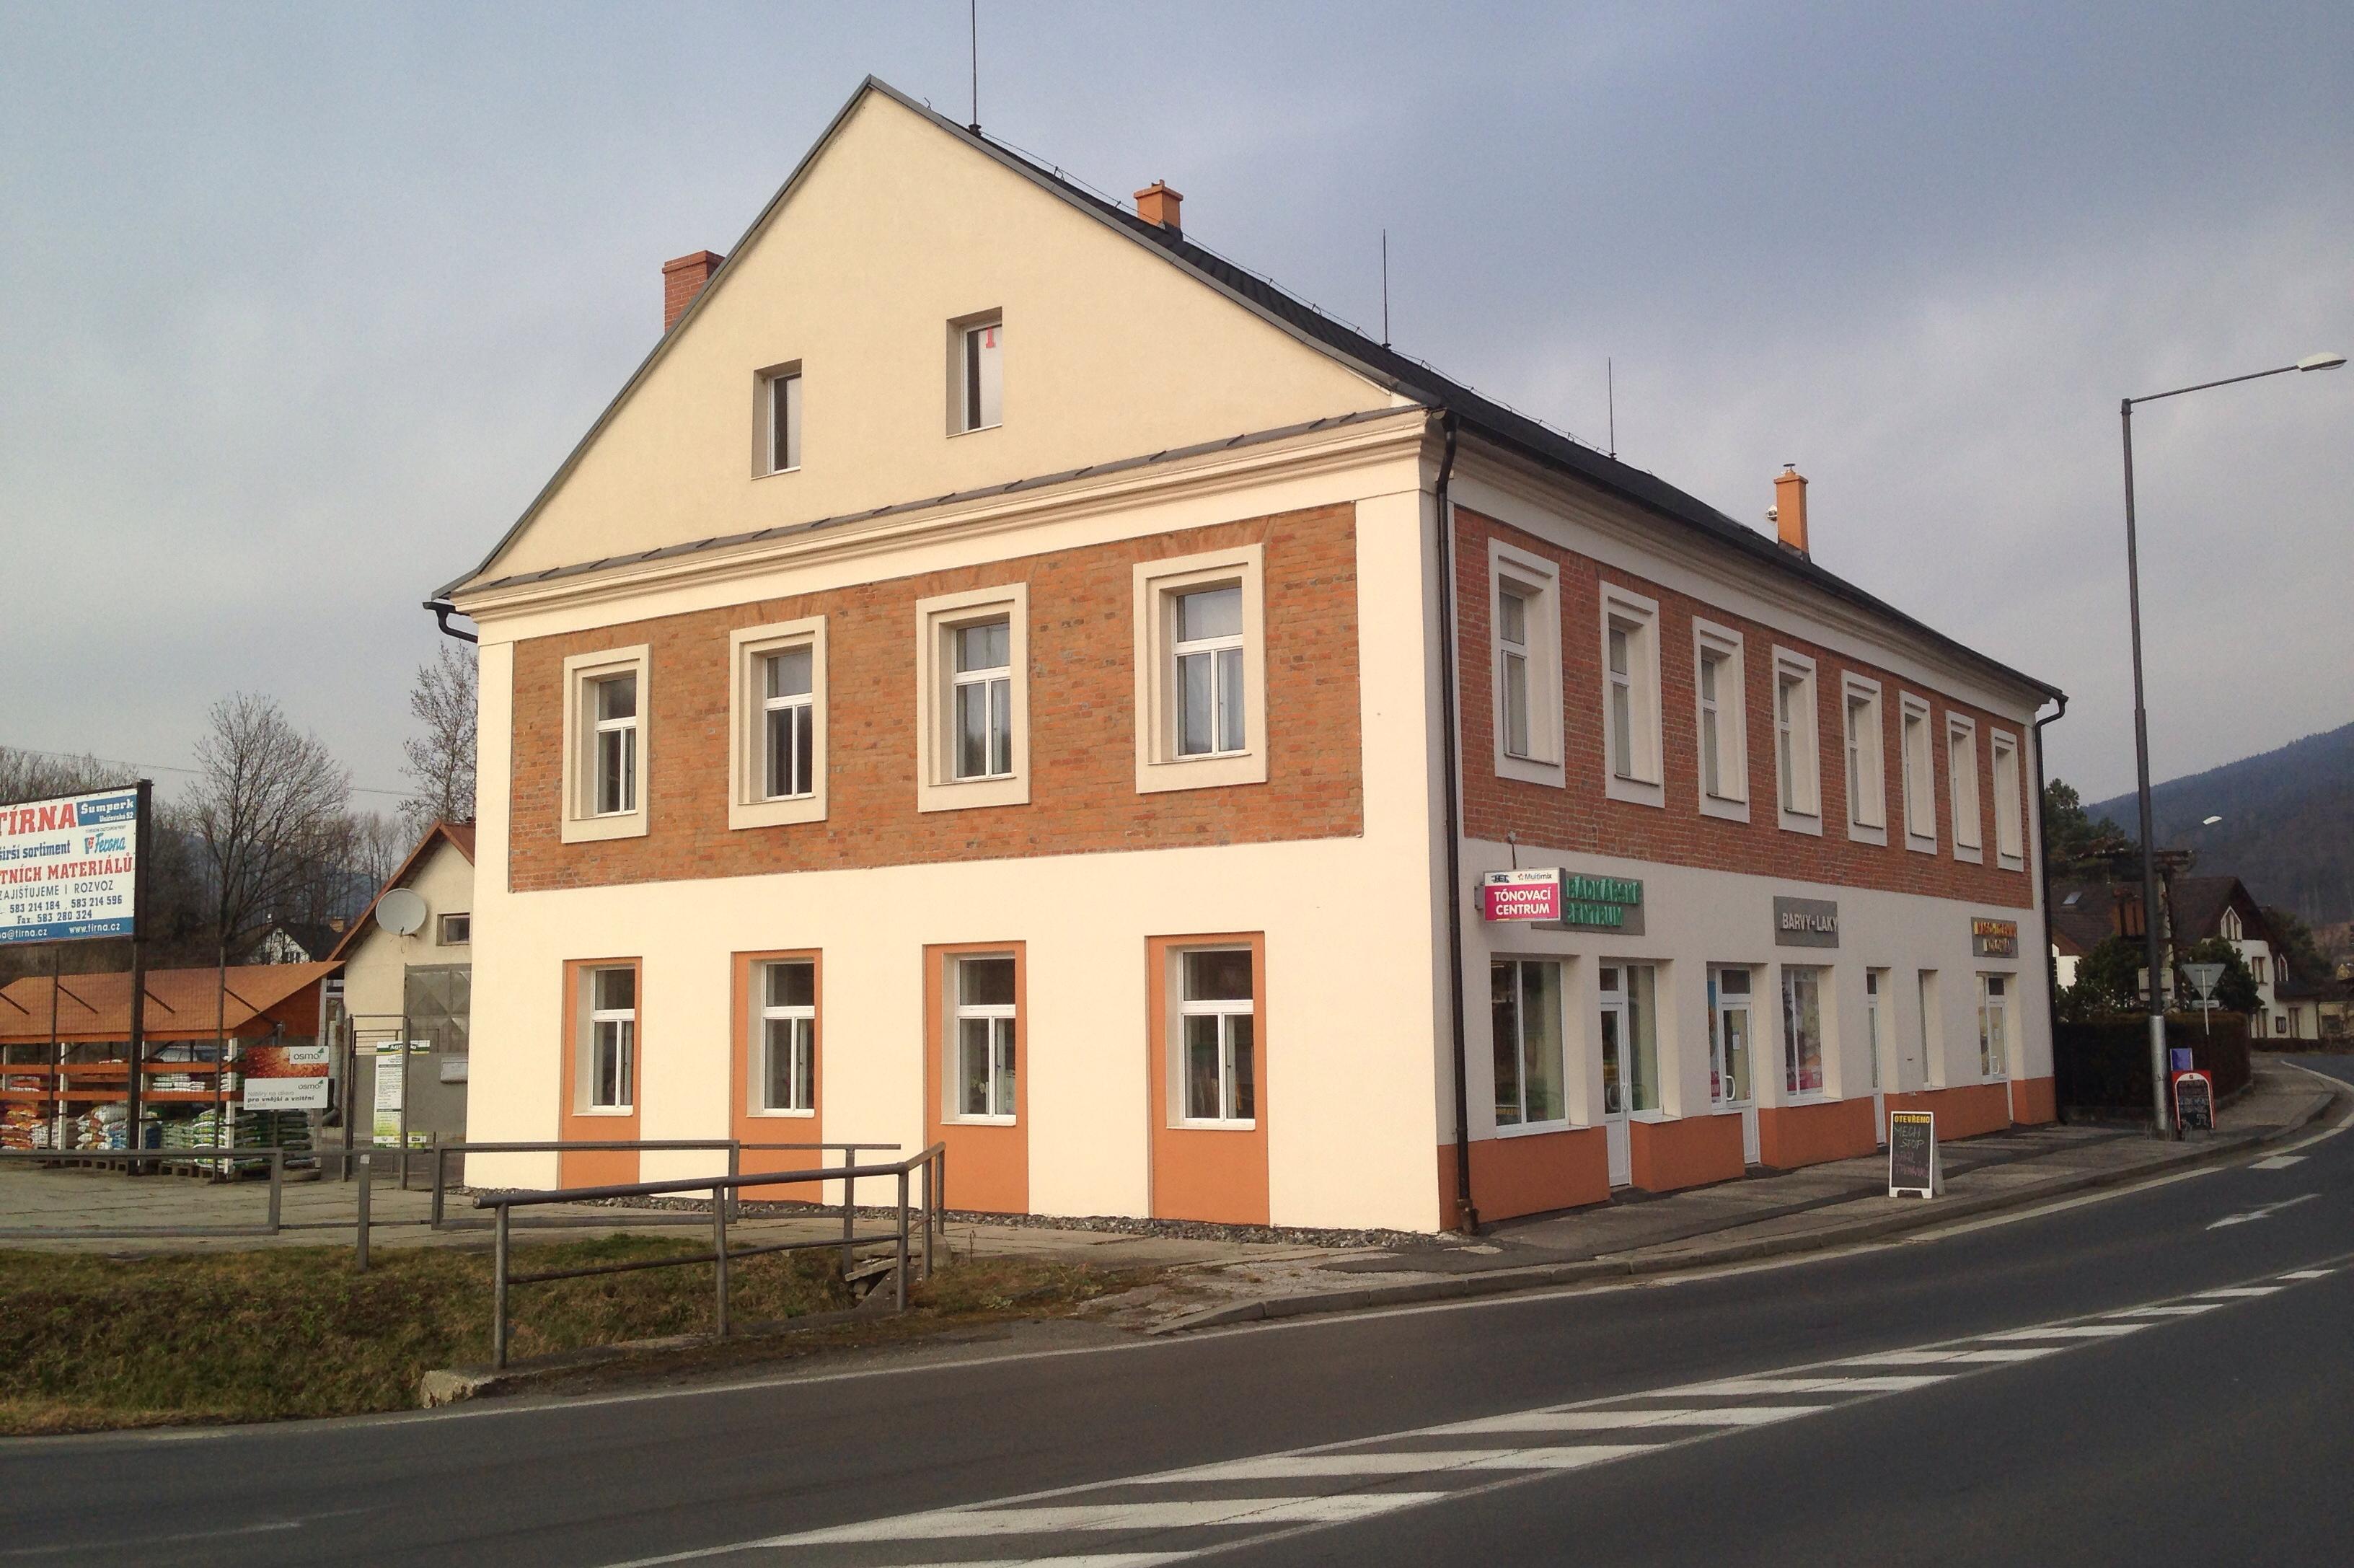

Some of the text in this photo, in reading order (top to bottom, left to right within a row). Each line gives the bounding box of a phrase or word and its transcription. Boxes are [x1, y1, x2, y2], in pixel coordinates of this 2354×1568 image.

[22, 840, 71, 859] sortiment
[48, 853, 133, 881] MATERIÁLŮ
[74, 880, 113, 894] ROZVOZ
[1494, 886, 1551, 902] TÓNOVACÍ
[9, 903, 25, 914] 583
[28, 902, 43, 912] 214
[71, 898, 87, 908] 583
[89, 897, 104, 907] 214
[106, 895, 123, 905] 596
[1496, 903, 1550, 916] CENTRUM
[38, 912, 53, 922] 583
[57, 911, 72, 921] 280
[76, 909, 92, 920] 324
[69, 923, 120, 934] www.tirna.cz
[1894, 1115, 1931, 1124] OTEVŘENO
